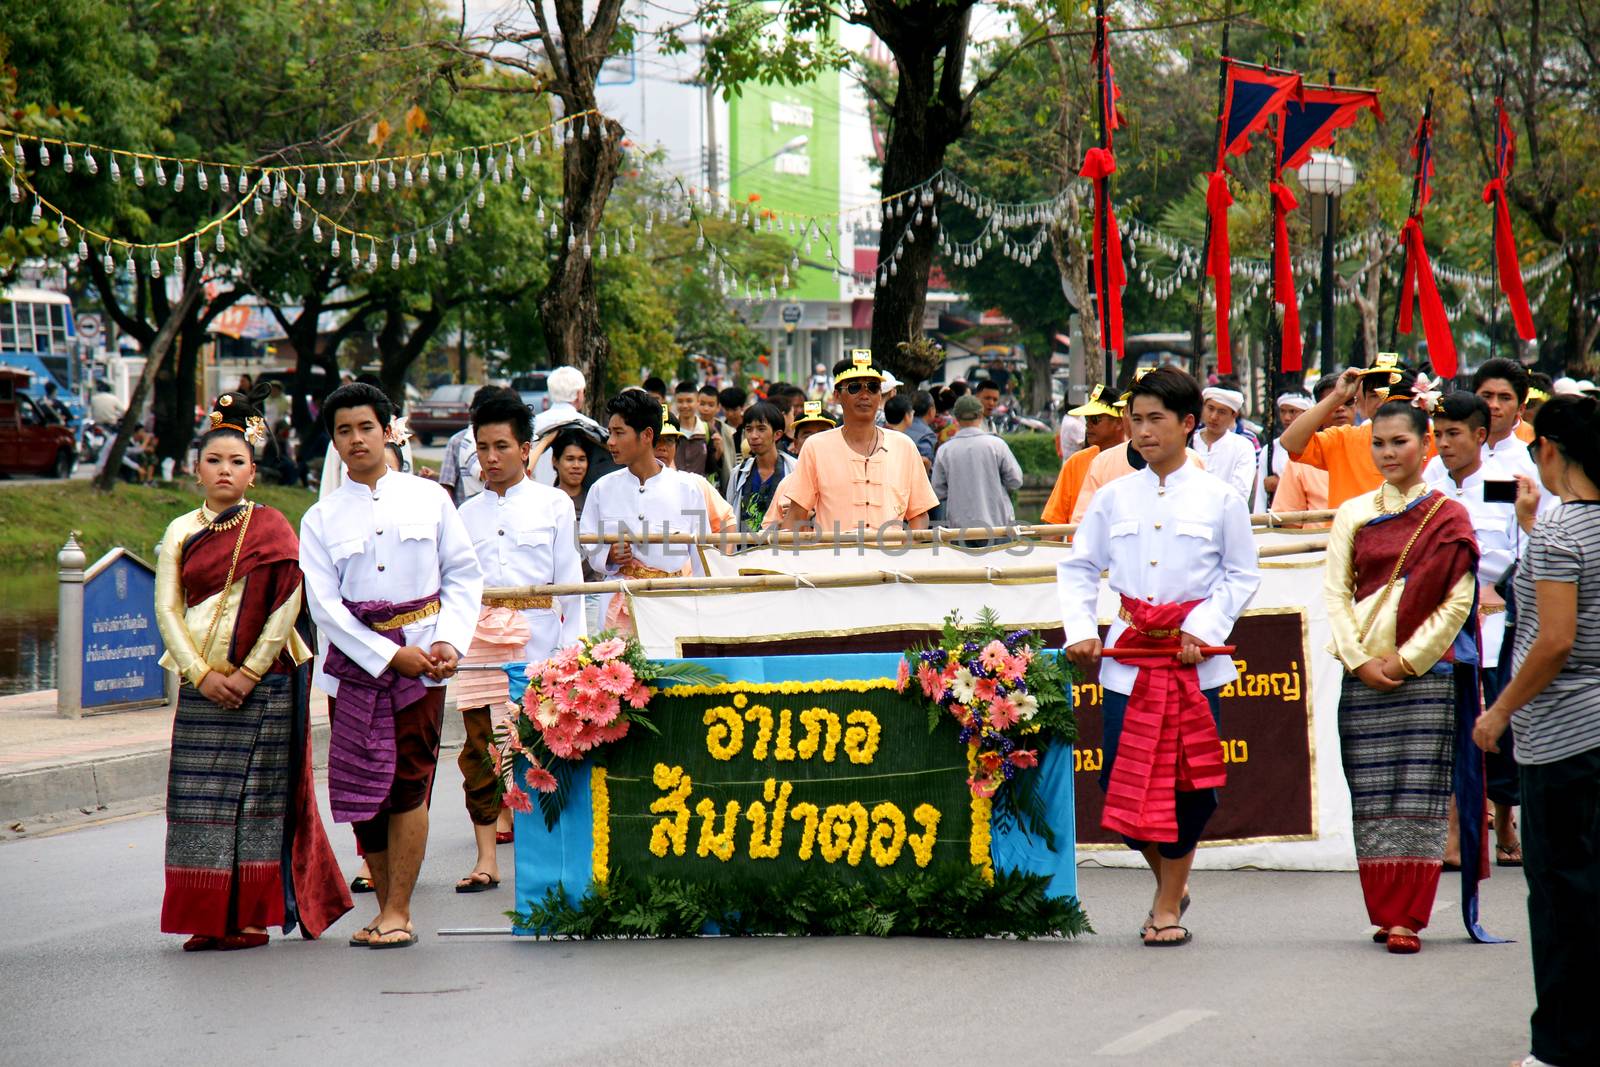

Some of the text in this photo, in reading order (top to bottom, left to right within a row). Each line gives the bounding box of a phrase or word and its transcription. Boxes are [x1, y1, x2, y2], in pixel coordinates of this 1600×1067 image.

[702, 693, 882, 765] อำเภอ
[649, 761, 942, 869] สันป่าตอง
